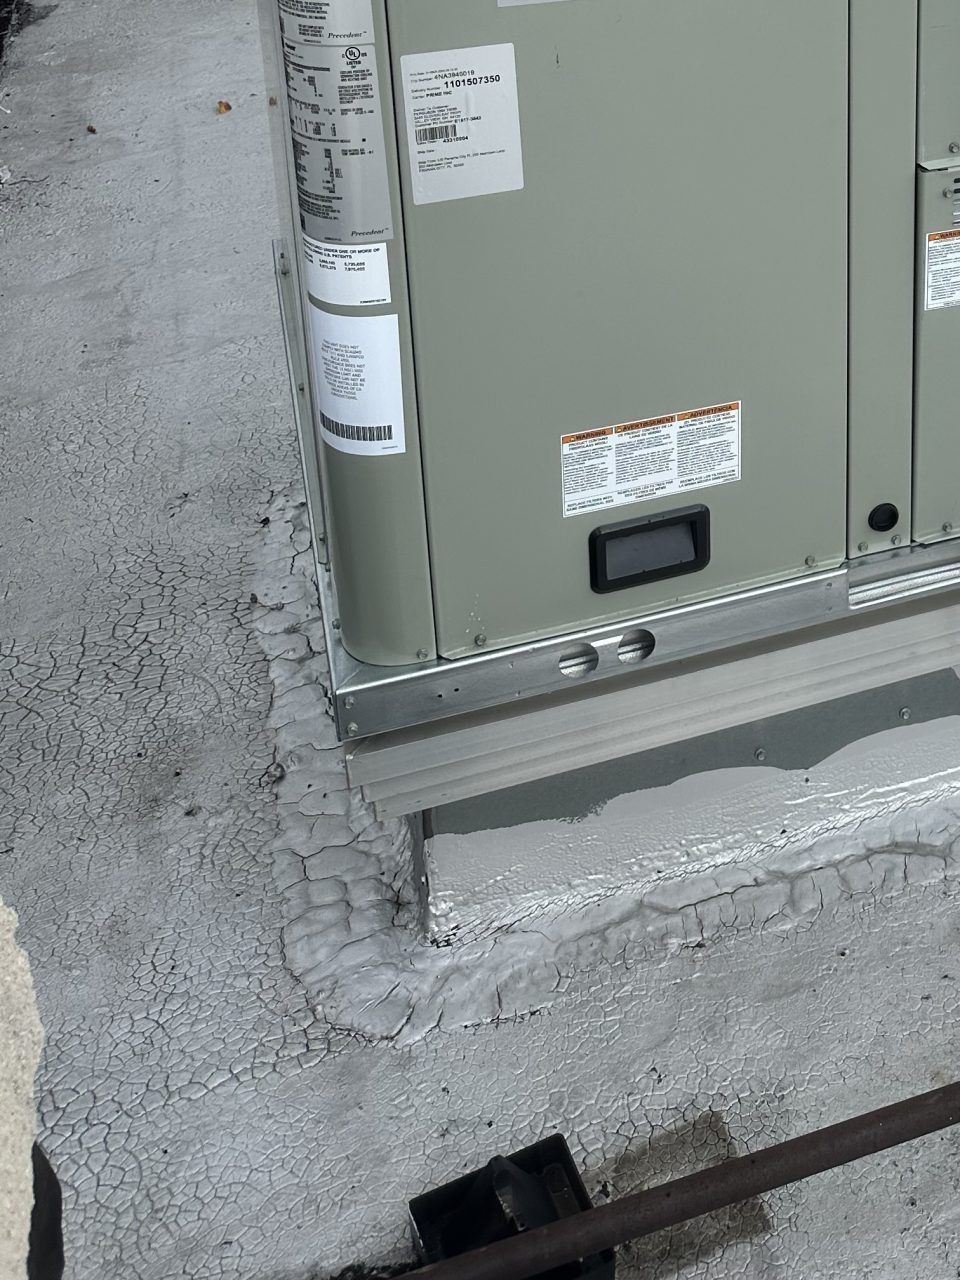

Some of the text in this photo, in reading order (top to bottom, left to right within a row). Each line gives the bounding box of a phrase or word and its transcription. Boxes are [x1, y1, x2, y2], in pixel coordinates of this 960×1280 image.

[444, 74, 500, 88] 1101507350
[689, 405, 733, 417] ADVERTENCIA
[576, 430, 606, 440] WARNING
